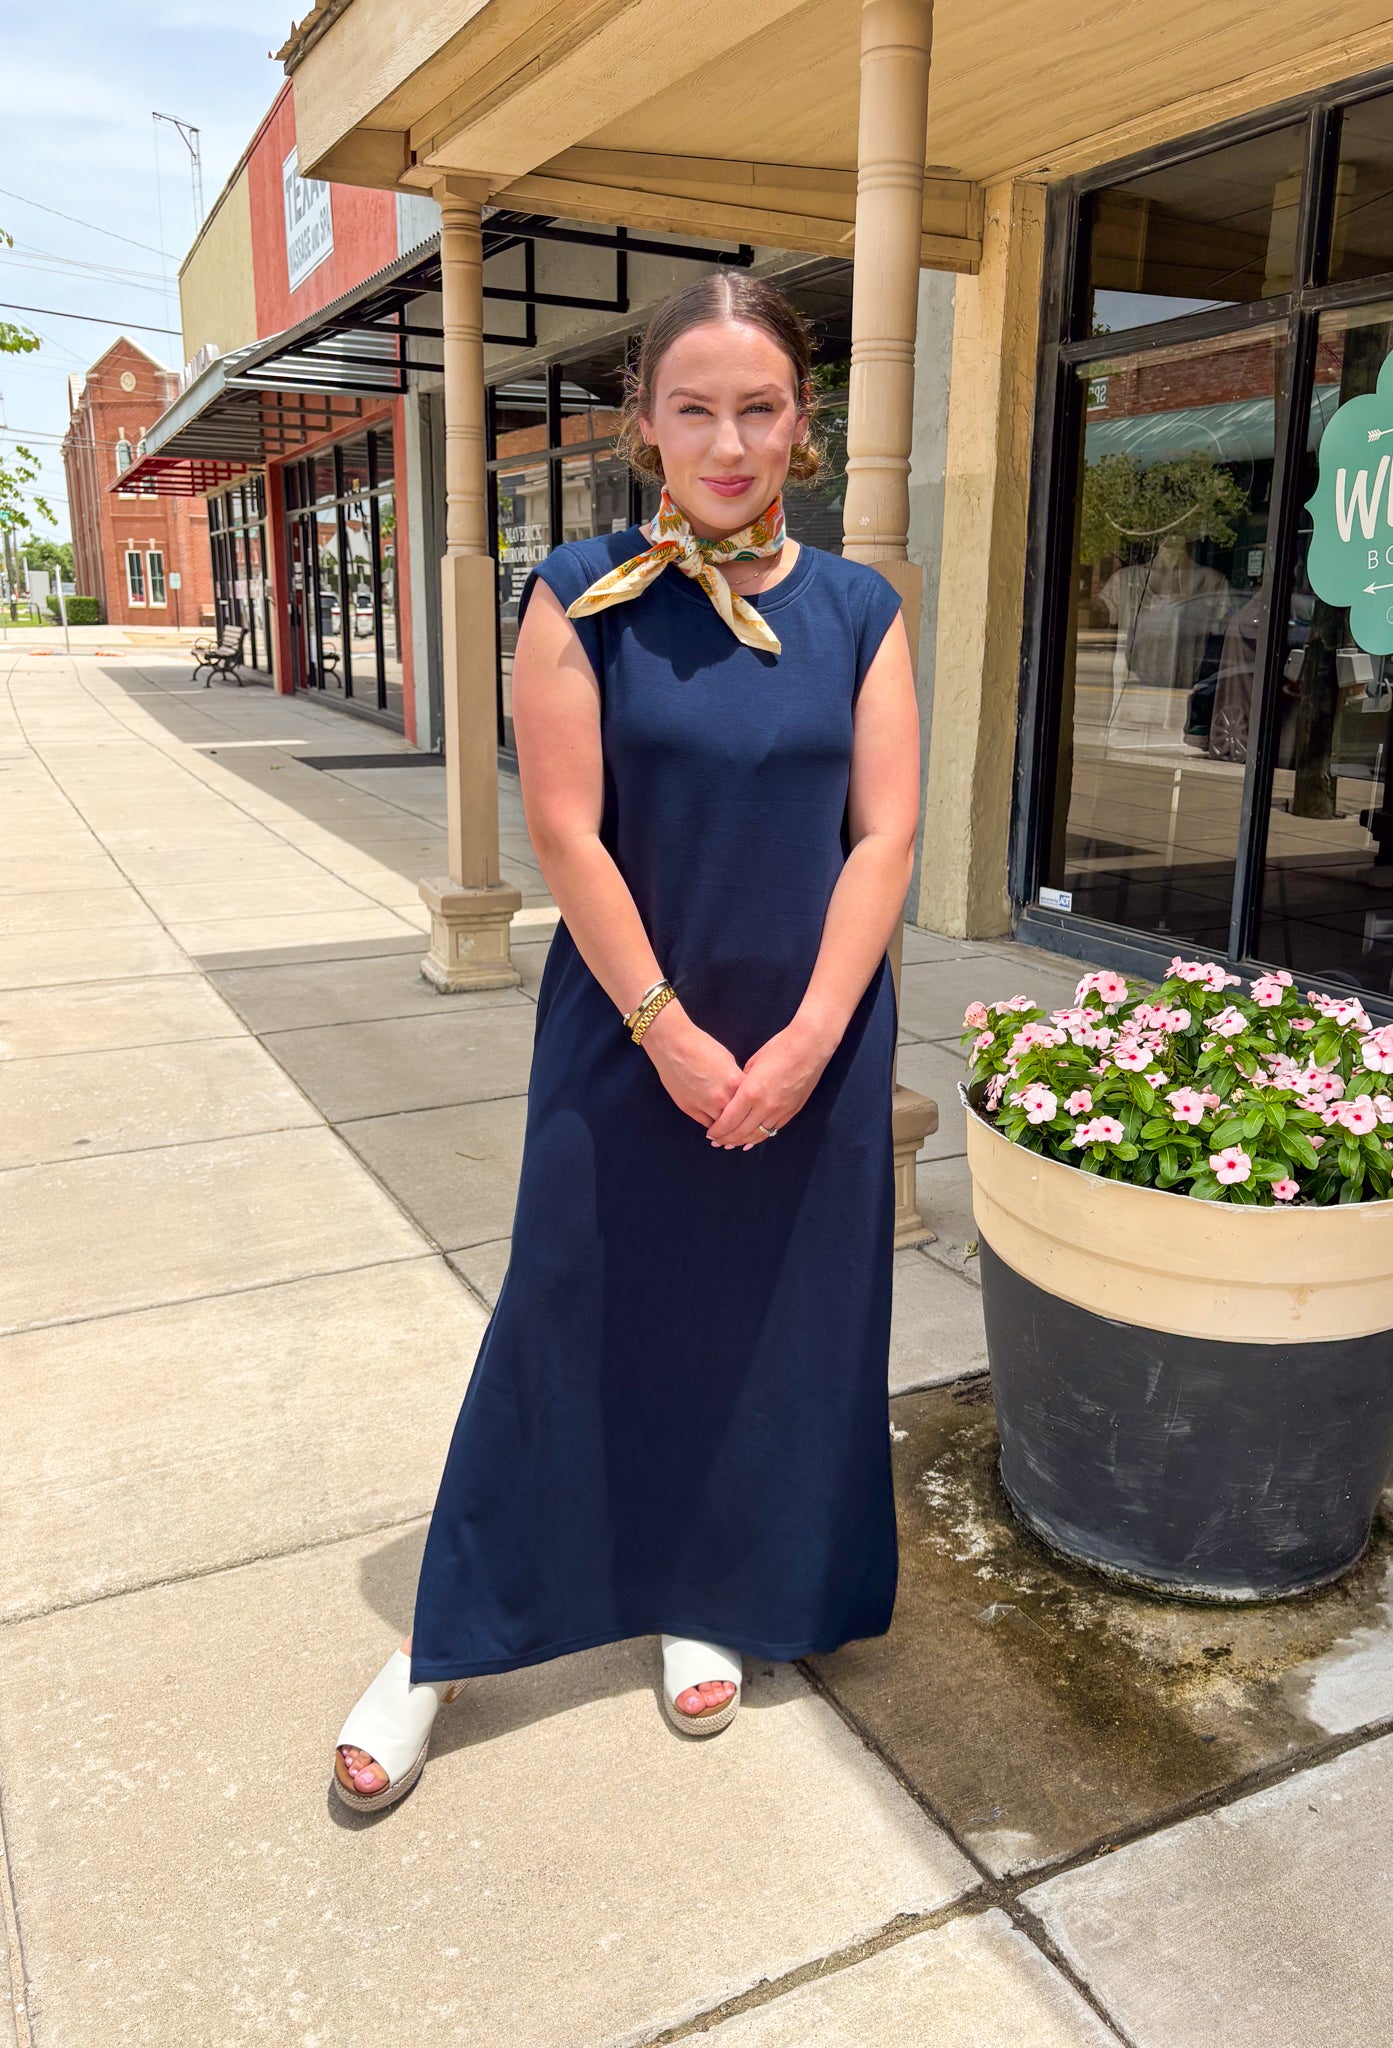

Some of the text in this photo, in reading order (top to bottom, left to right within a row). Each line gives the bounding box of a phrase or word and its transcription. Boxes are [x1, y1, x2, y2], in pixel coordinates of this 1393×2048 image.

[319, 203, 332, 244] SPA
[1335, 454, 1393, 543] W
[505, 524, 542, 543] MAVERICK
